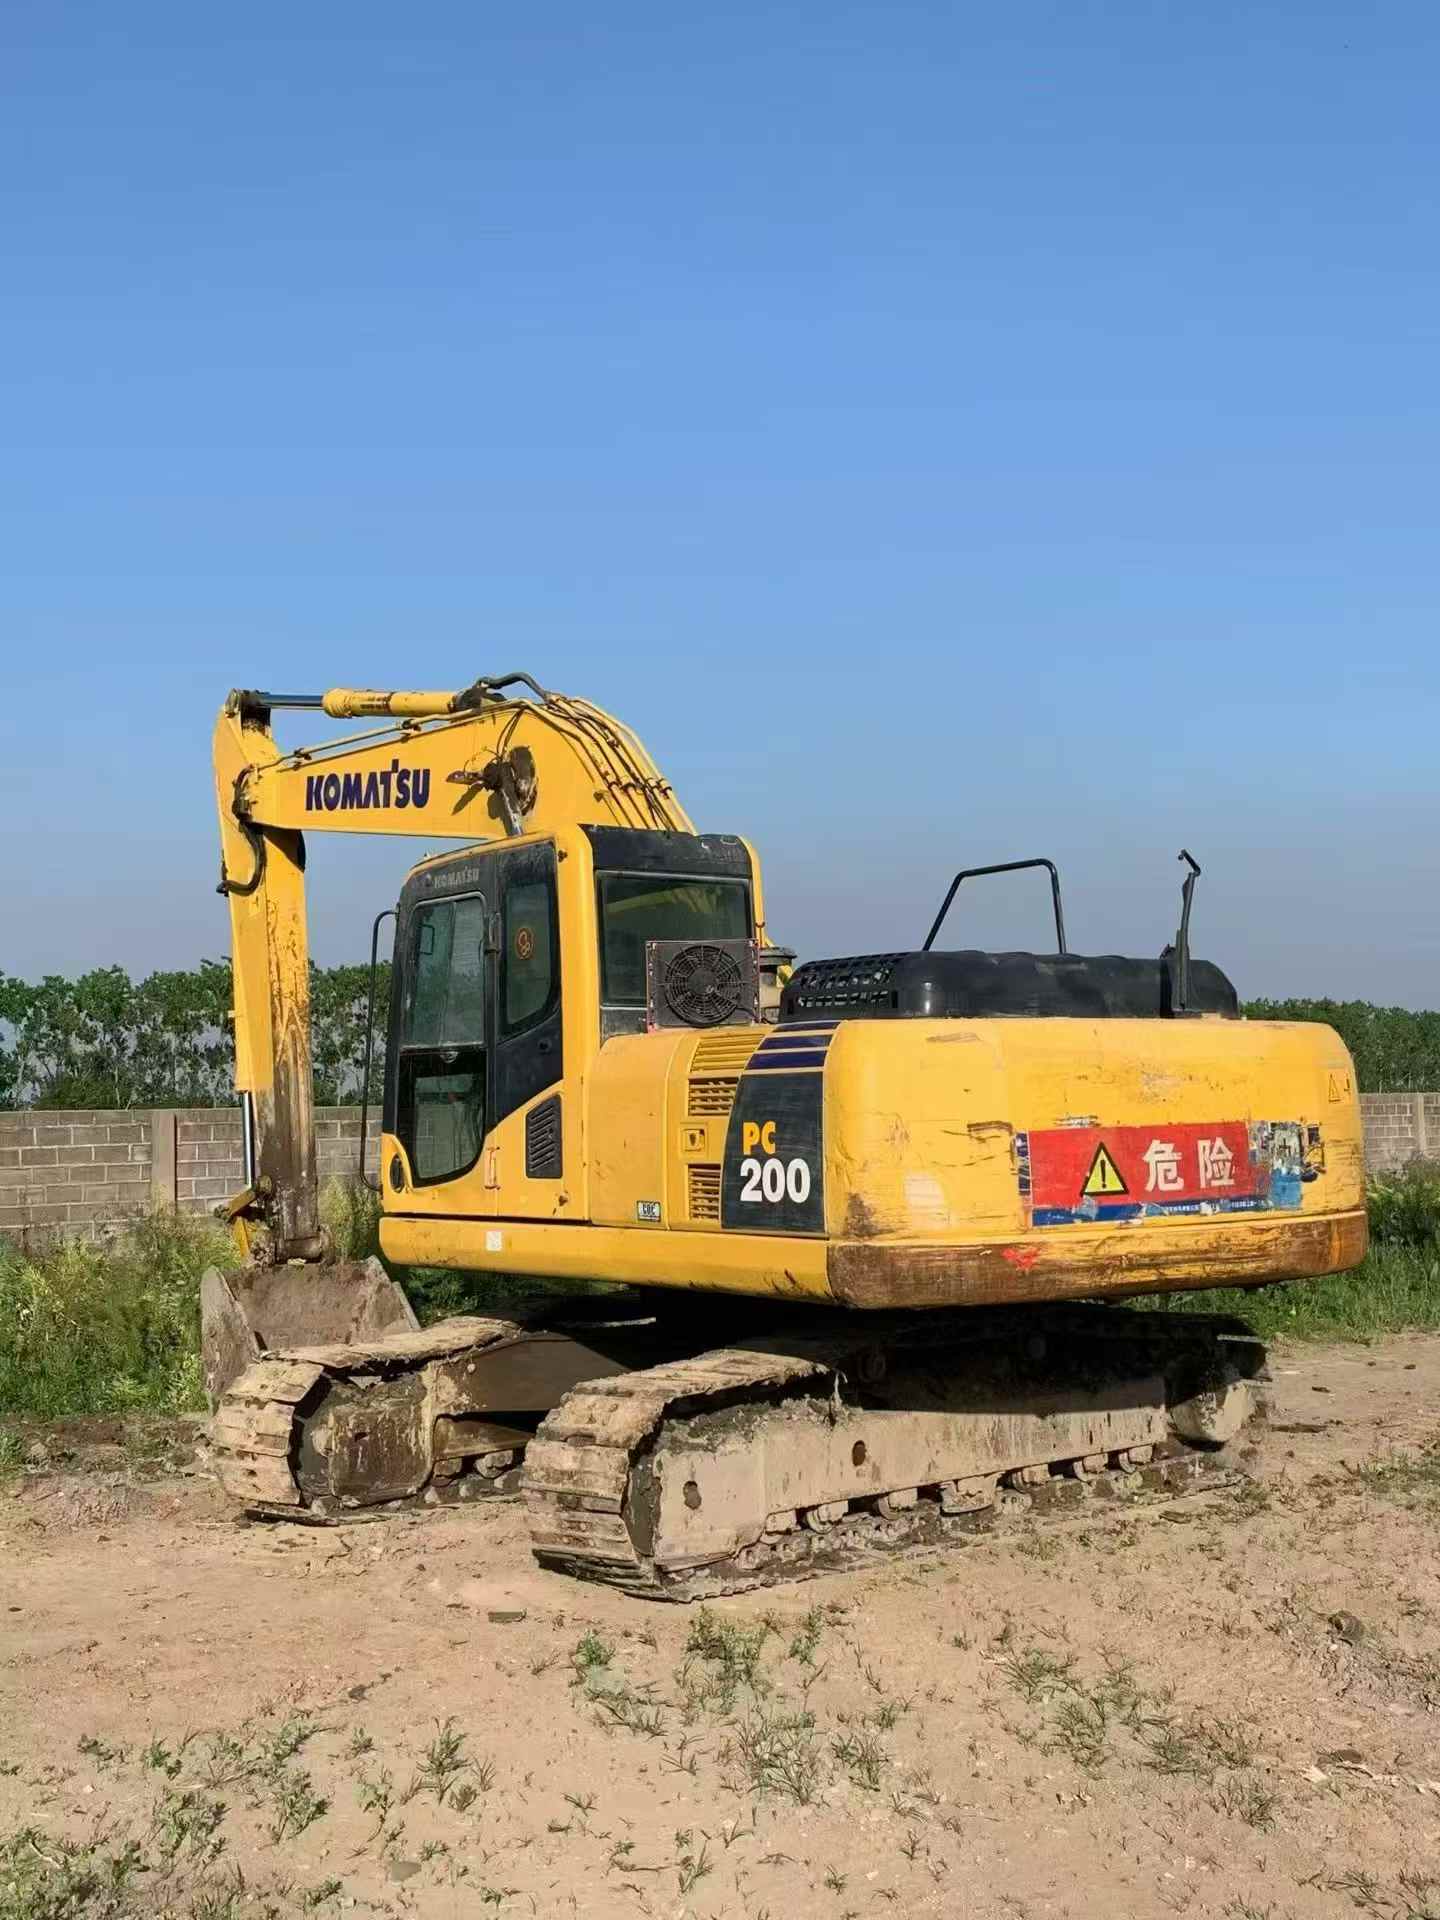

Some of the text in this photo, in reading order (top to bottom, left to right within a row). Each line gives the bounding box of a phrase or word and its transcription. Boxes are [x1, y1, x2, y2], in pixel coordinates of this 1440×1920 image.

[305, 758, 431, 811] KOMATSU
[434, 866, 480, 888] KOMATSU
[743, 1121, 777, 1156] PC
[740, 1158, 811, 1204] 200
[1142, 1136, 1236, 1192] 危险
